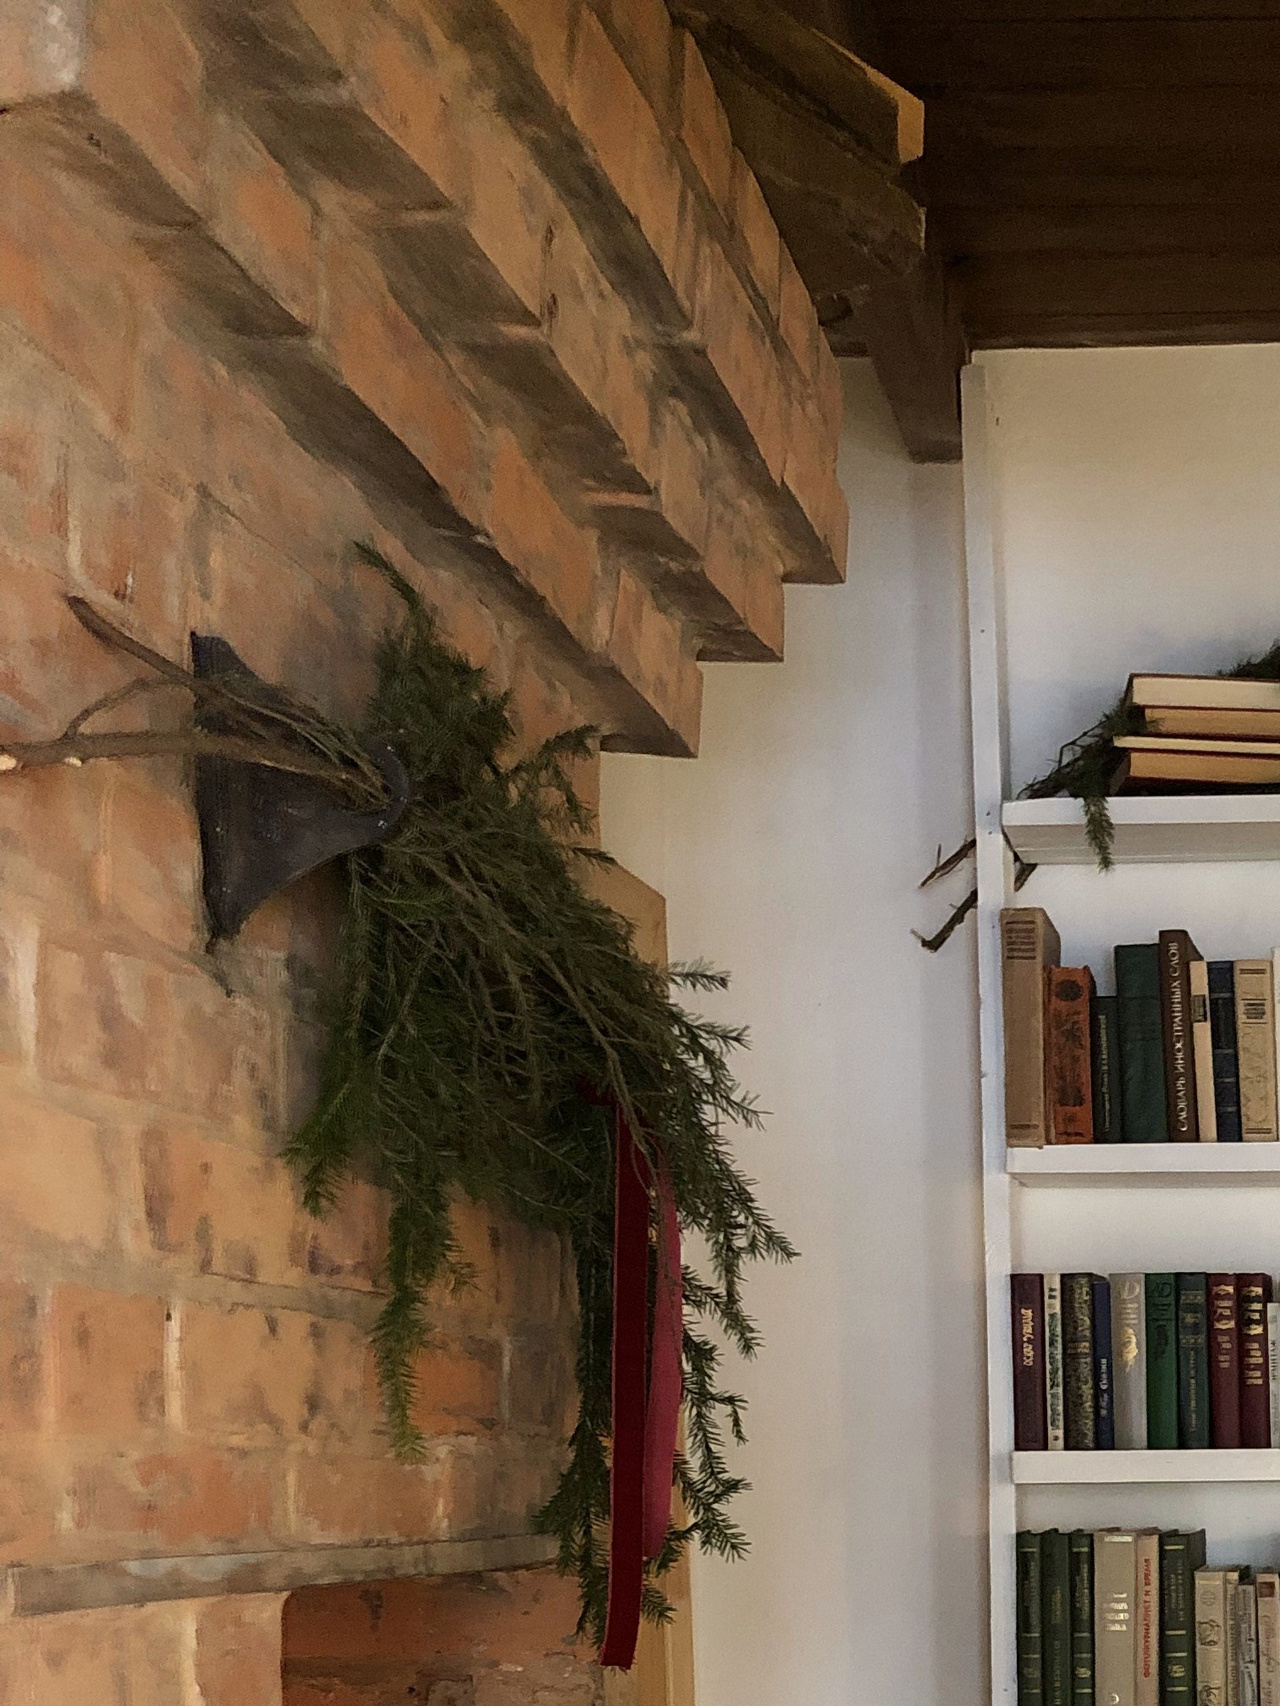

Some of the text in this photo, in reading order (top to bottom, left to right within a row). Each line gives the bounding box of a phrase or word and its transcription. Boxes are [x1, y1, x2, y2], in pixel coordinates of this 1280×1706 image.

[1168, 943, 1188, 1131] СЛОВАРЬ ИНОСТРАННЫХ СЛОВ
[1142, 1558, 1151, 1586] ВРЕМЯ
[1139, 1599, 1153, 1678] ФОТОЖУРНАЛИСТ
